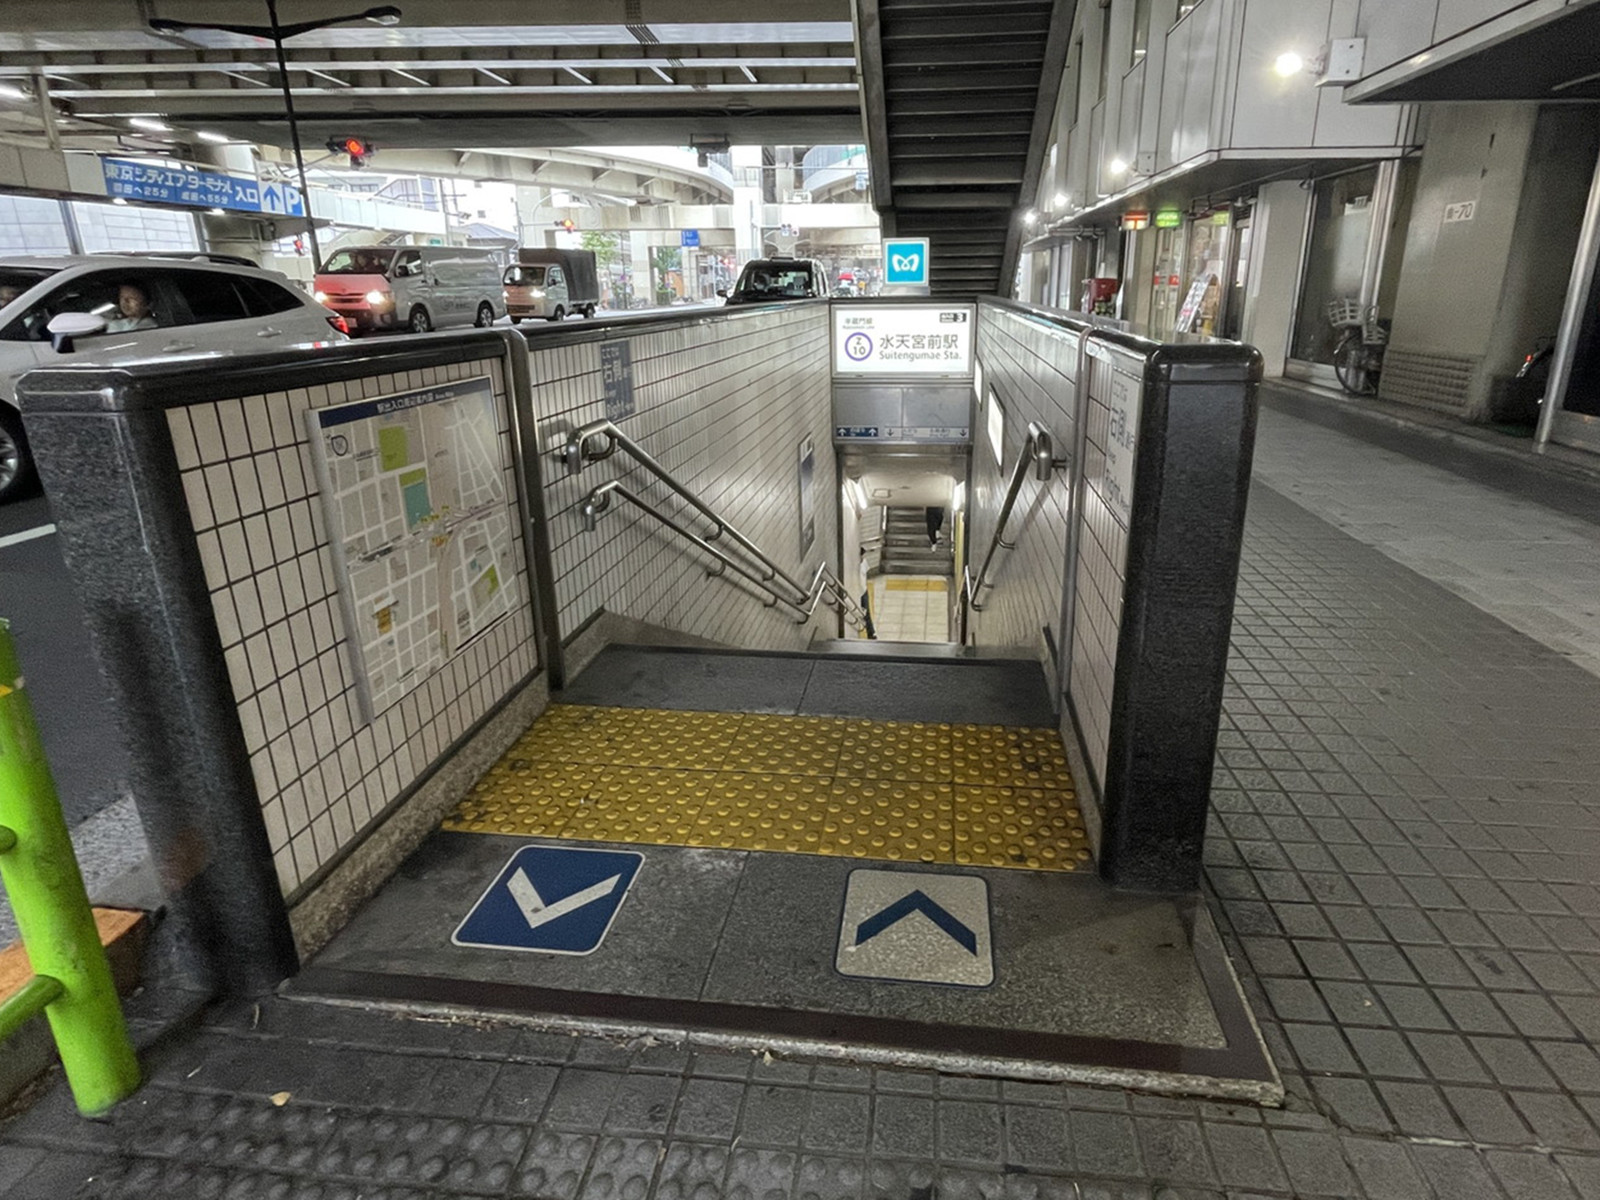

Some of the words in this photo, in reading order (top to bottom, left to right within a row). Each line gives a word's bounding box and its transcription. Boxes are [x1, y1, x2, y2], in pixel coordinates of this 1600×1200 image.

[105, 163, 233, 194] 東京シティエアターミナル
[236, 185, 259, 205] 入口
[285, 187, 300, 212] P
[957, 312, 964, 323] 3
[856, 337, 862, 345] Z
[879, 334, 959, 350] 水天宮前駅
[853, 346, 866, 356] 10
[879, 351, 942, 362] Suitengumae
[944, 351, 962, 360] Sta.
